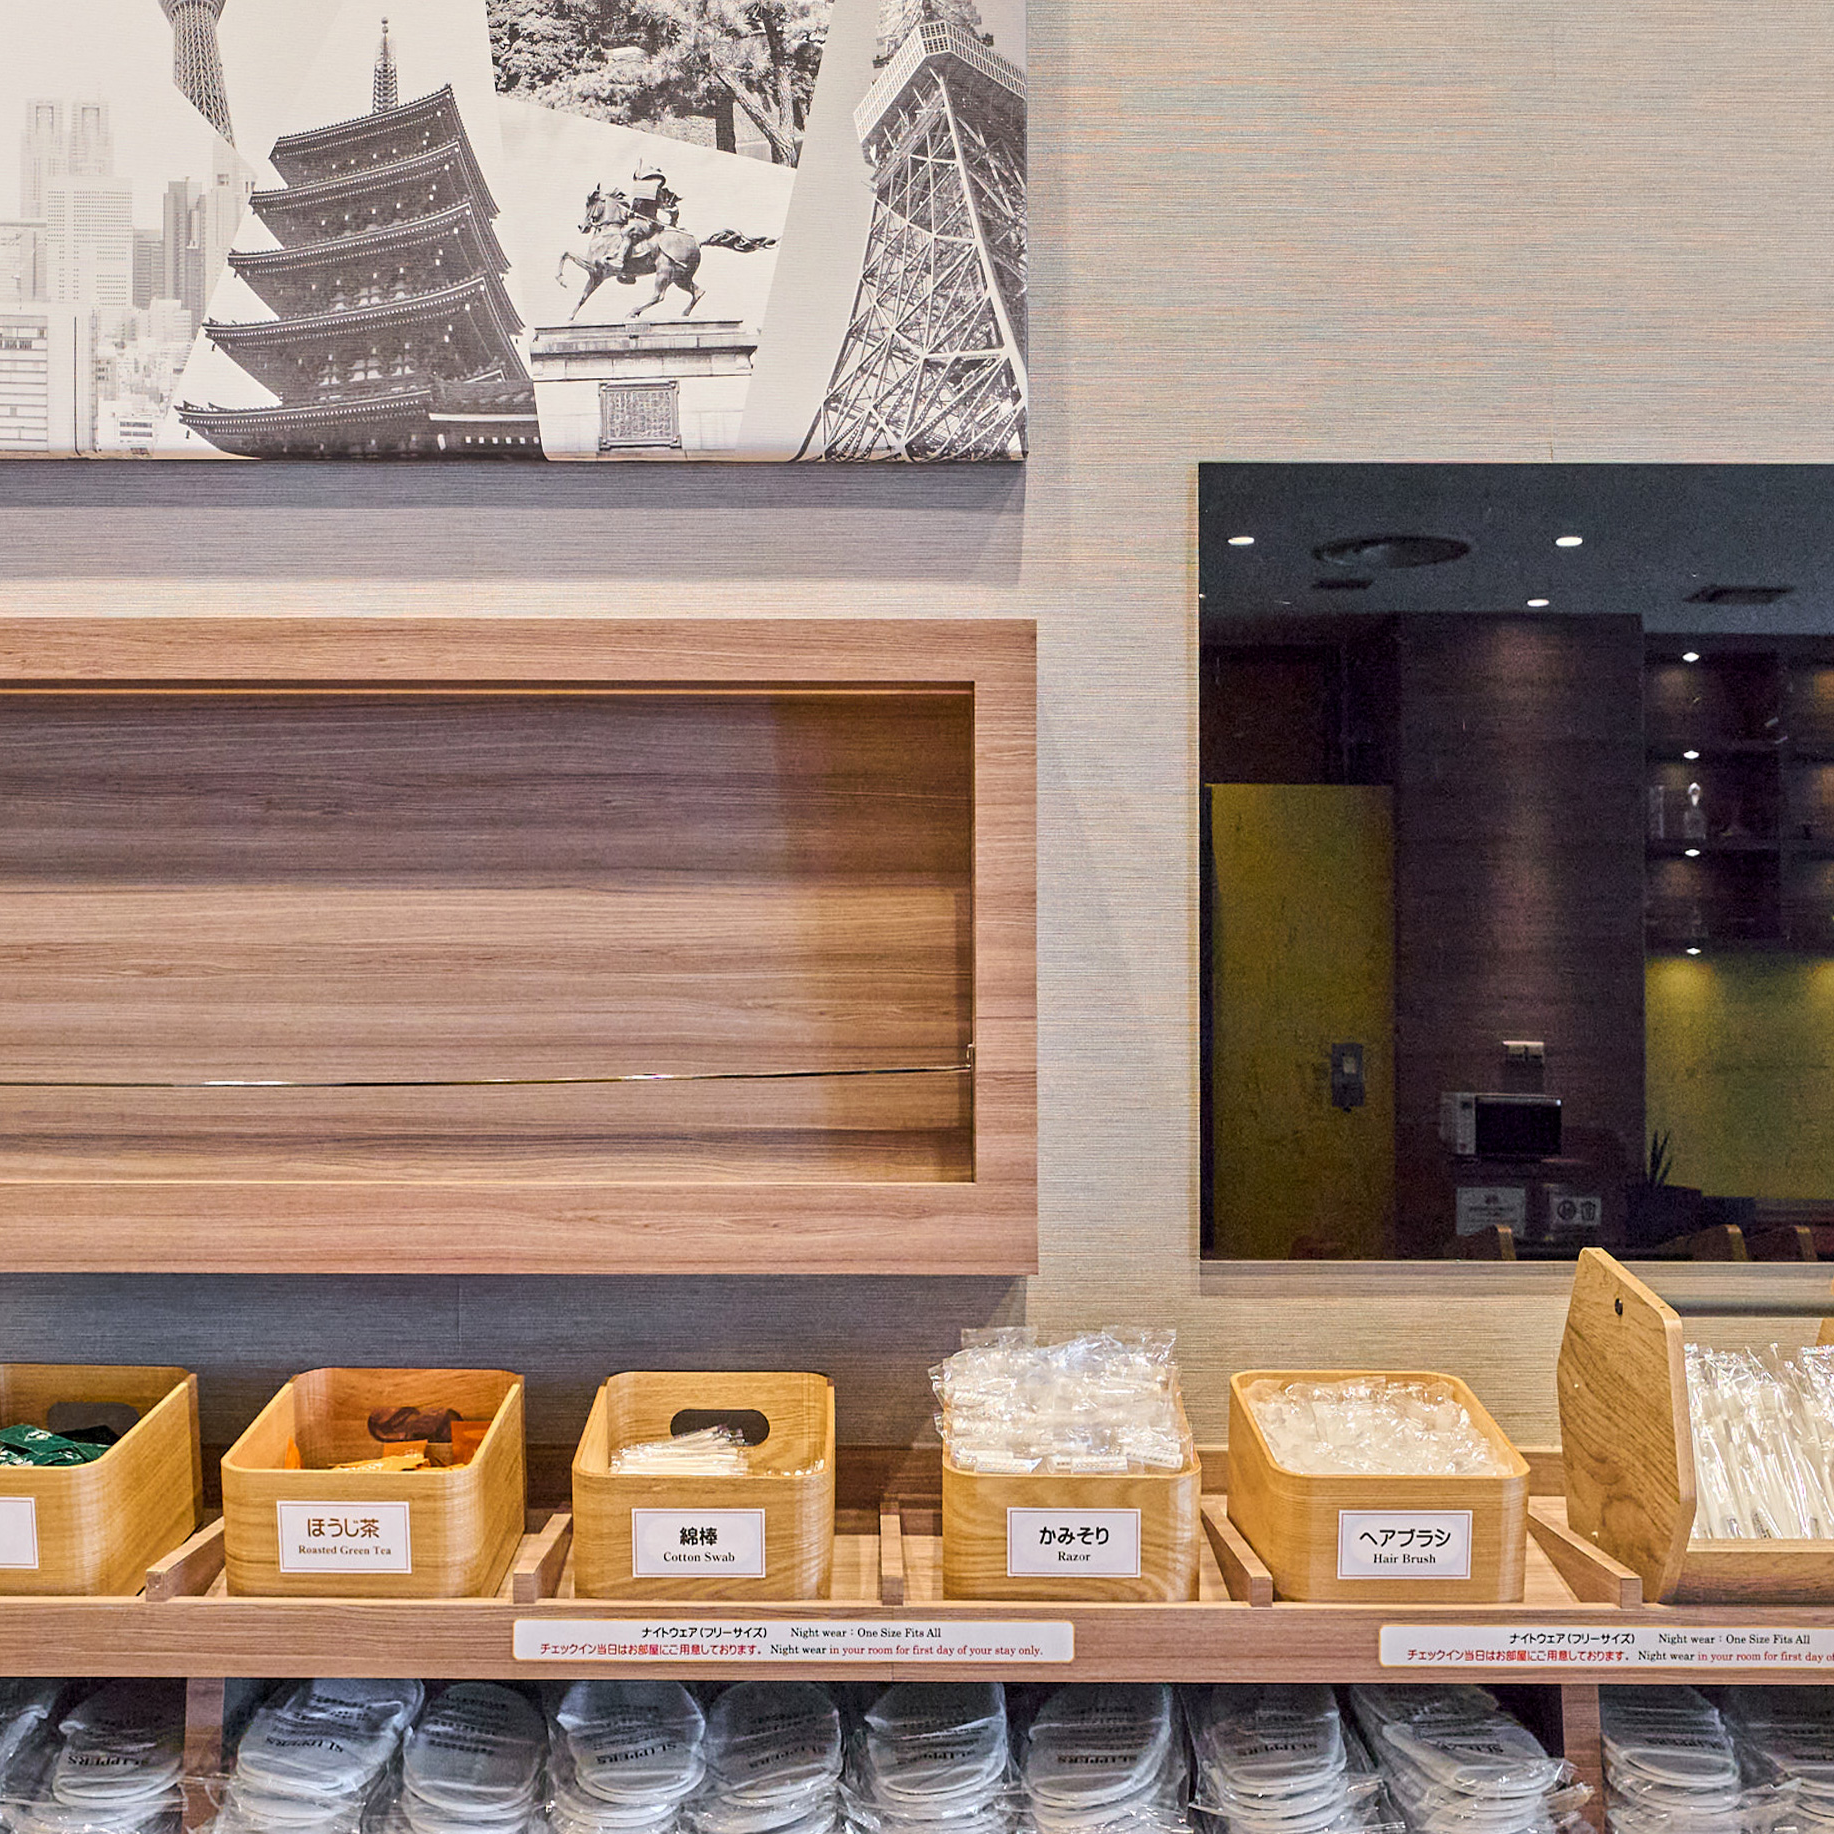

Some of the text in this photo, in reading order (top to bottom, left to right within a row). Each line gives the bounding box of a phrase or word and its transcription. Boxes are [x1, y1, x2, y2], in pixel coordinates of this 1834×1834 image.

[307, 1517, 380, 1539] ほうじ茶
[679, 1526, 718, 1547] 綿棒
[1038, 1525, 1110, 1546] かみそり
[1359, 1528, 1452, 1548] ヘアブラシ
[298, 1544, 392, 1556] Roasted Green Tea
[1057, 1551, 1092, 1562] Razor
[663, 1551, 736, 1563] Cotton Swab
[1373, 1553, 1436, 1564] Hair Brush
[790, 1627, 820, 1640] Night
[821, 1630, 848, 1638] wear
[857, 1627, 879, 1638] One
[880, 1627, 902, 1638] Size
[904, 1627, 925, 1638] Fits
[926, 1627, 942, 1638] All
[1658, 1633, 1688, 1646] Night
[1690, 1636, 1716, 1645] wear
[1725, 1633, 1747, 1645] One
[1748, 1633, 1771, 1644] Size
[1772, 1633, 1794, 1645] Fits
[1794, 1633, 1811, 1645] All
[770, 1643, 1044, 1658] Night wear in your room for first day of your stay only.
[1638, 1650, 1667, 1663] Night
[1669, 1653, 1696, 1662] wear
[1697, 1651, 1708, 1662] in
[1710, 1653, 1734, 1664] your
[1736, 1653, 1761, 1662] room
[1763, 1650, 1779, 1662] for
[1780, 1650, 1803, 1662] first
[1804, 1651, 1824, 1664] day
